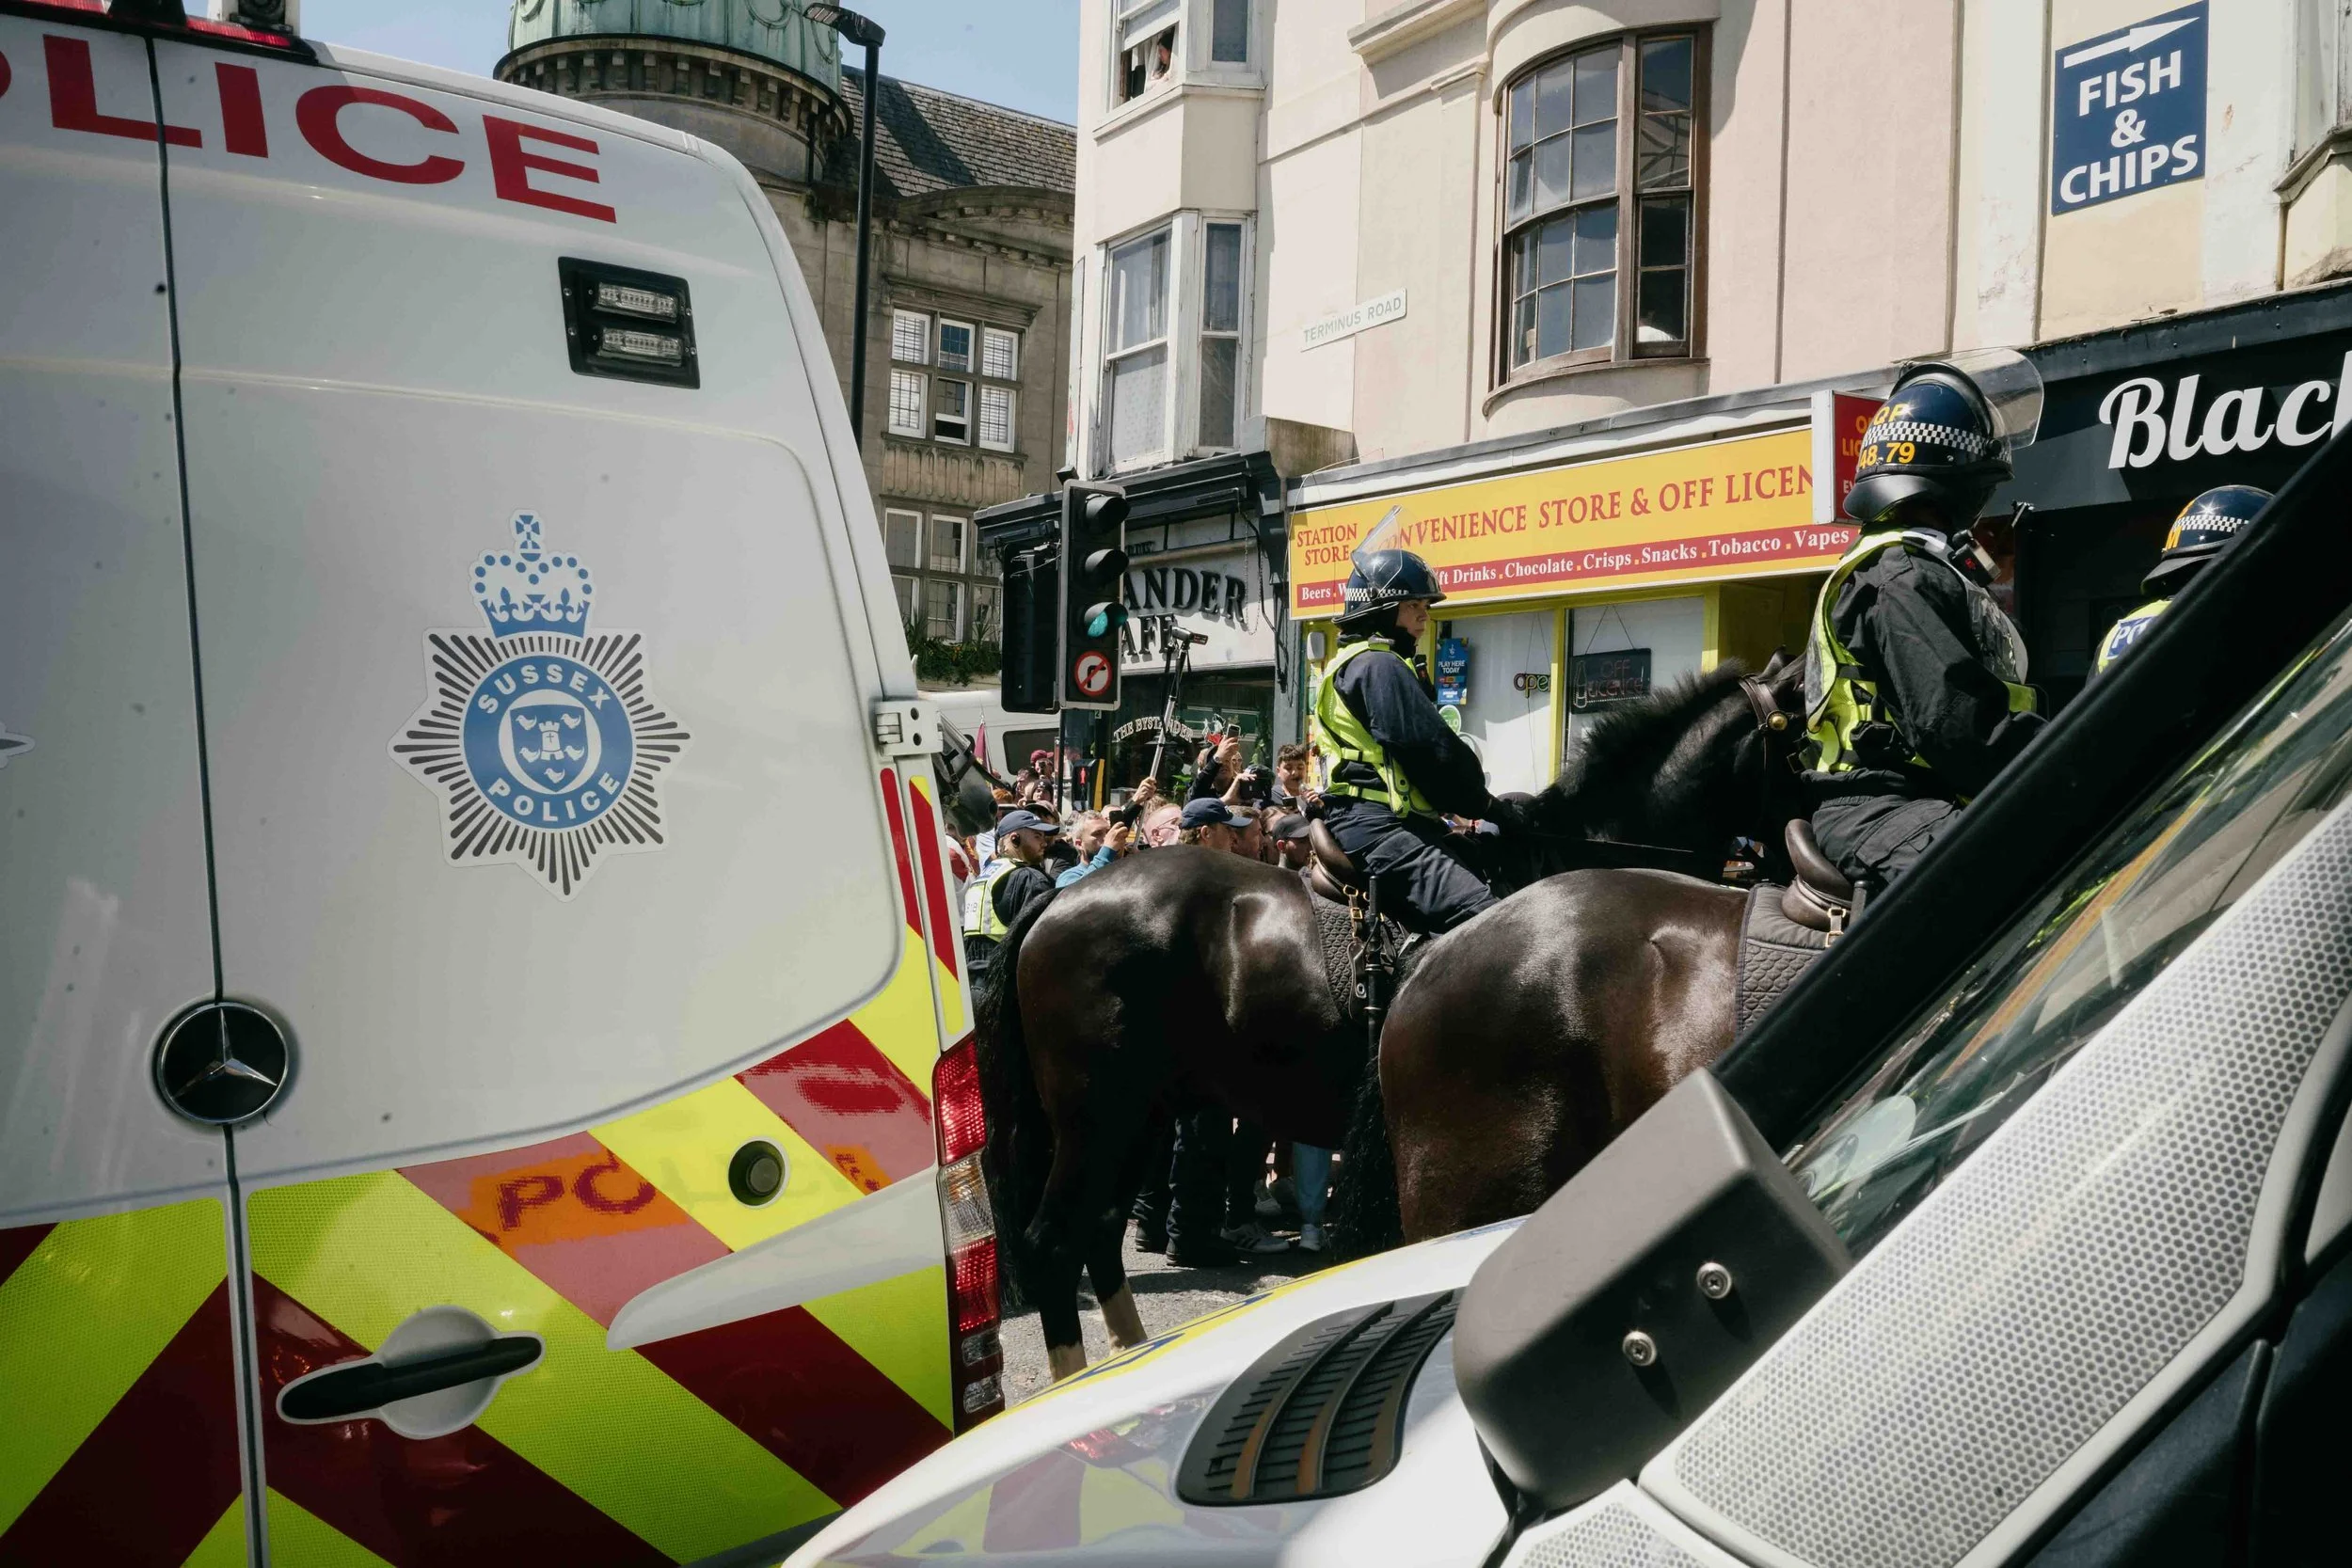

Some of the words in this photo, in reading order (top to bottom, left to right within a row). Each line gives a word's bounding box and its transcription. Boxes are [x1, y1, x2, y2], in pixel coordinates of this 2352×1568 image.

[2078, 50, 2182, 118] FISH
[0, 34, 617, 225] LICE
[2110, 108, 2147, 149] &
[2059, 135, 2199, 204] CHIPS
[1303, 310, 1362, 343] TERMINUS
[1367, 296, 1403, 322] ROAD
[1859, 444, 1879, 469] 48
[1885, 441, 1916, 465] 79
[1538, 491, 1622, 529] STORE
[1630, 487, 1652, 516] &
[1659, 477, 1714, 513] OFF
[1296, 523, 1359, 547] STATION
[1305, 545, 1350, 566] STORE
[1301, 586, 1331, 601] Beers
[1435, 569, 1449, 585] ft
[1453, 566, 1497, 584] Drinks
[1505, 558, 1574, 578] Chocolate
[1583, 551, 1632, 571] Crisps
[1641, 544, 1697, 564] Snacks
[1708, 534, 1781, 558] Tobacco
[1792, 529, 1851, 549] Vapes
[1438, 660, 1451, 669] PLAY
[478, 664, 612, 715] SUSSEX
[1113, 721, 1136, 743] THE
[487, 771, 621, 822] POLICE
